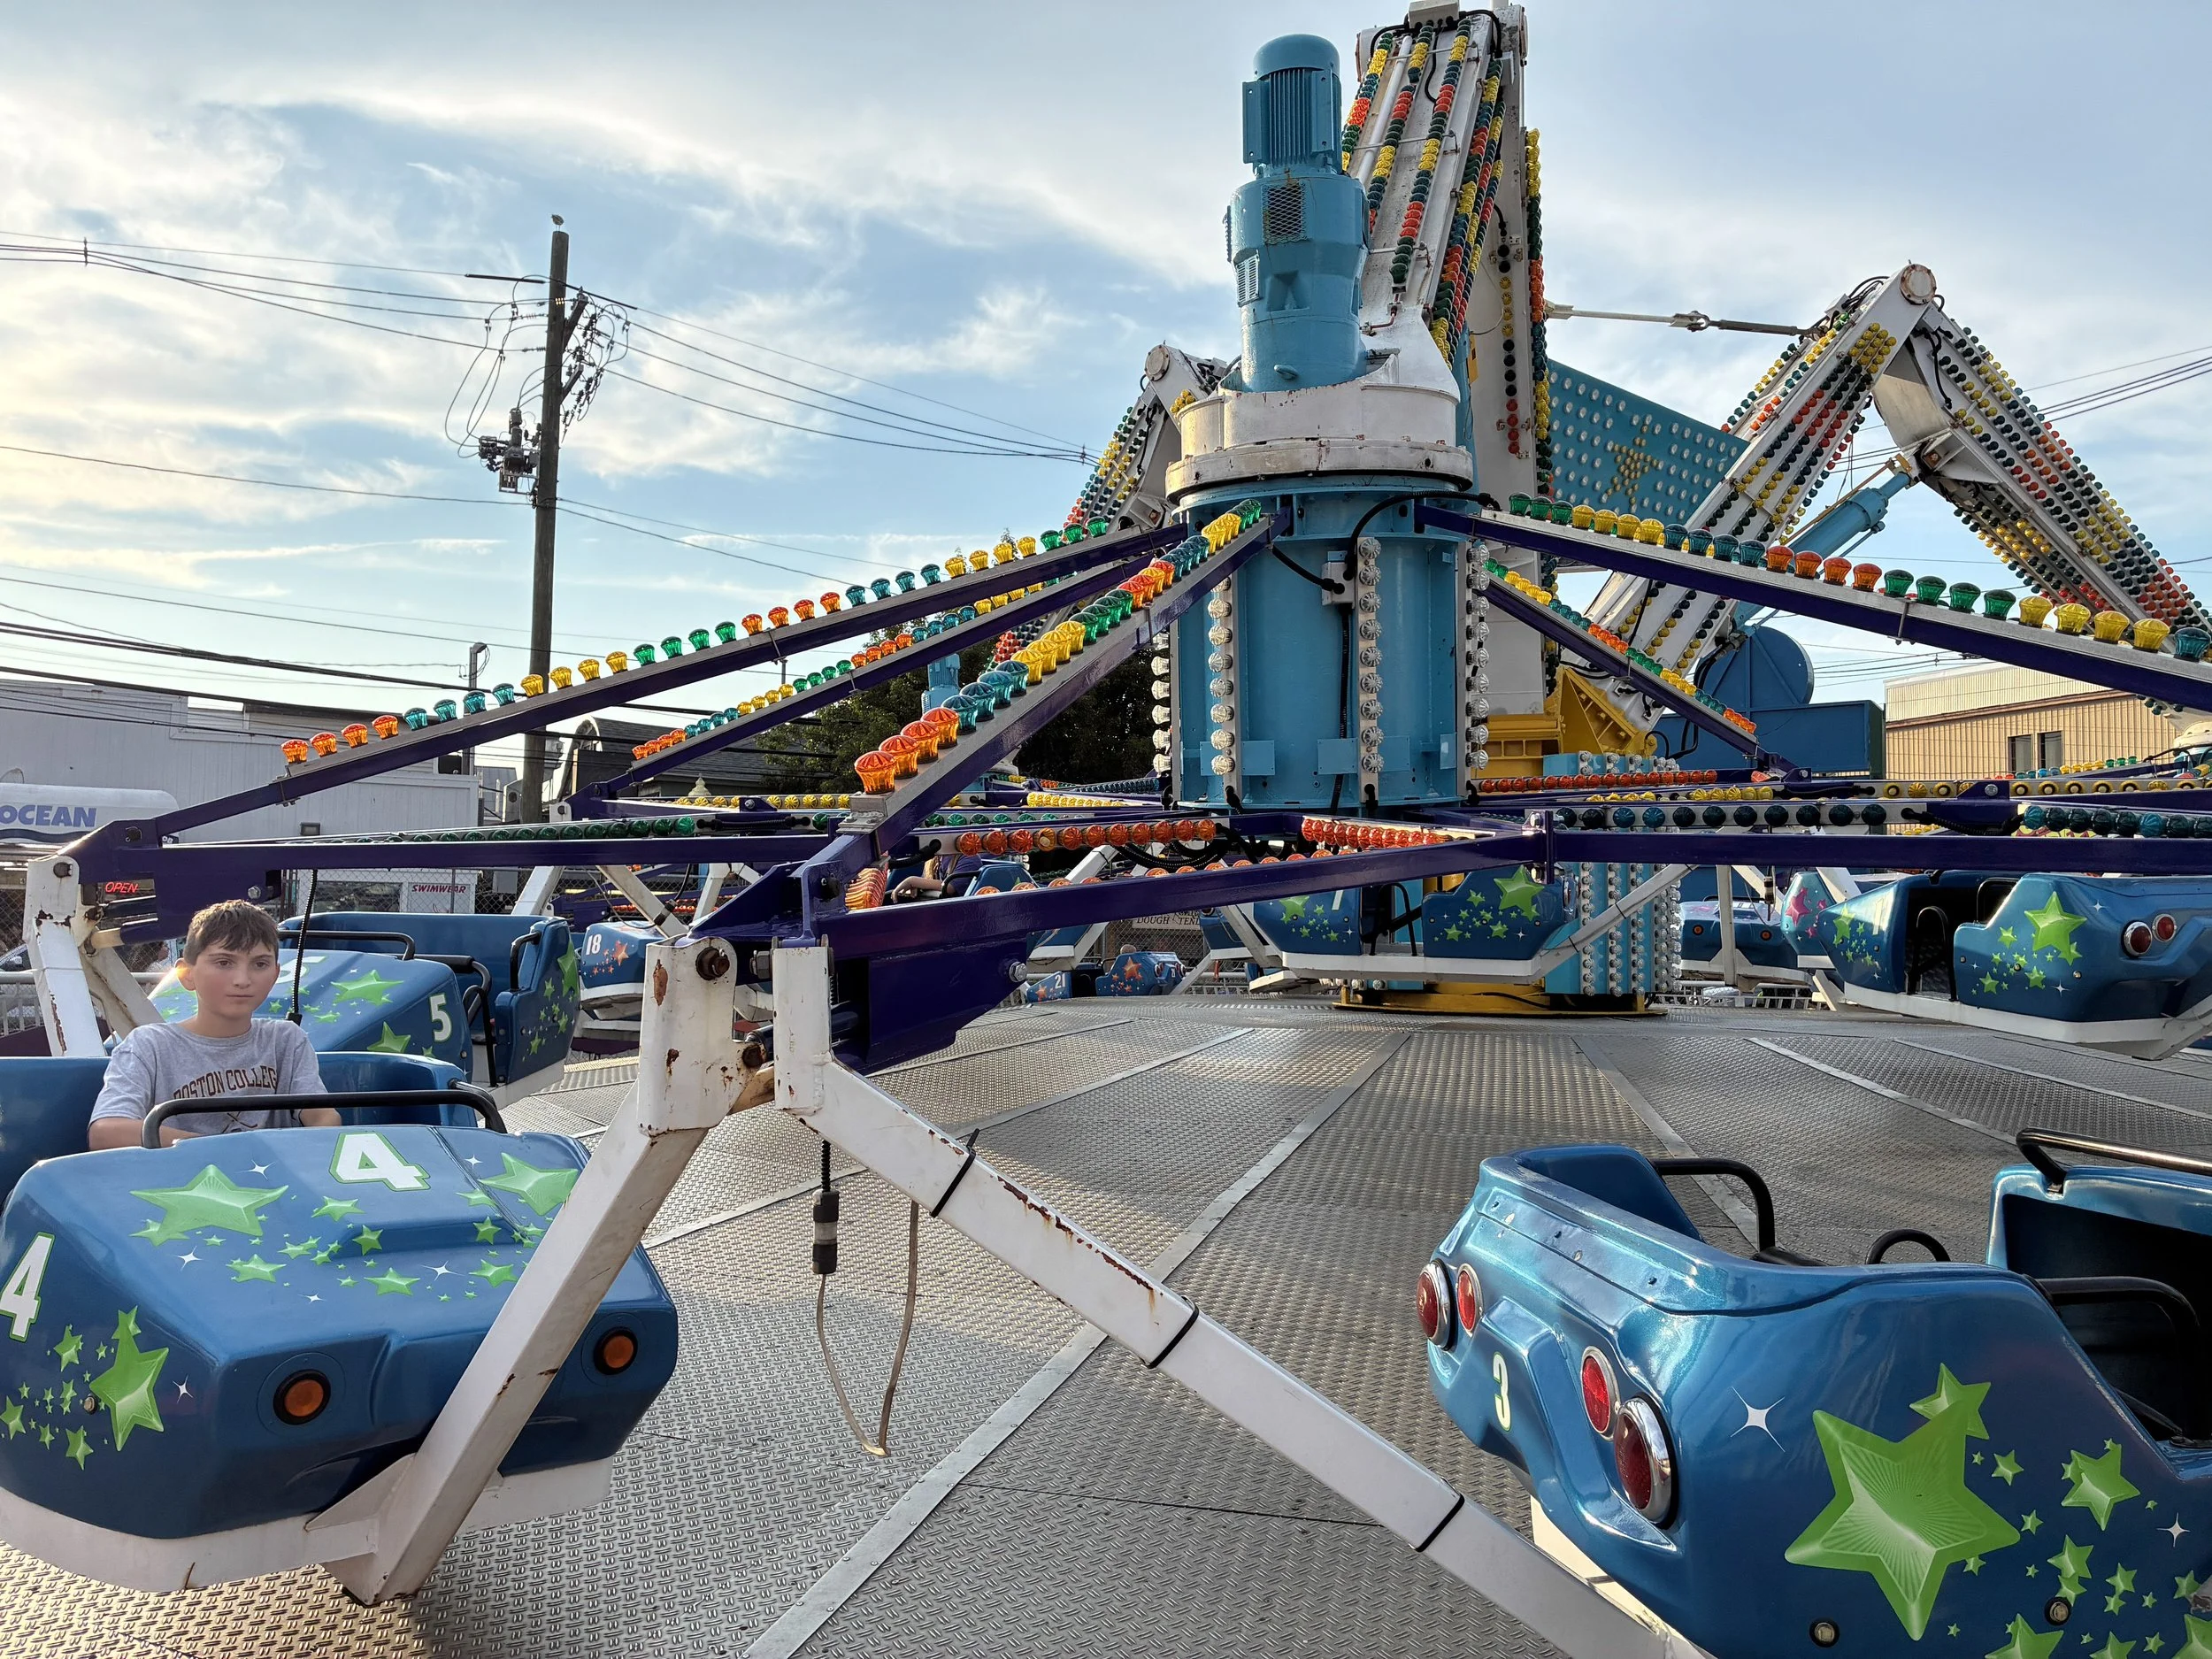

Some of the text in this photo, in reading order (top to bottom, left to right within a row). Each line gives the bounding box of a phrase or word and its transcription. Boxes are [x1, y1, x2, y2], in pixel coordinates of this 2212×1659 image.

[0, 804, 97, 827] OCEAN
[104, 881, 139, 894] OPEN
[411, 885, 466, 894] SWIMWEAR
[1136, 916, 1170, 925] DOUGH
[586, 933, 602, 956] 18
[1055, 972, 1066, 989] 21
[429, 993, 452, 1042] 5
[329, 1132, 431, 1192] 4
[0, 1231, 55, 1341] 4
[1493, 1351, 1511, 1432] 3
